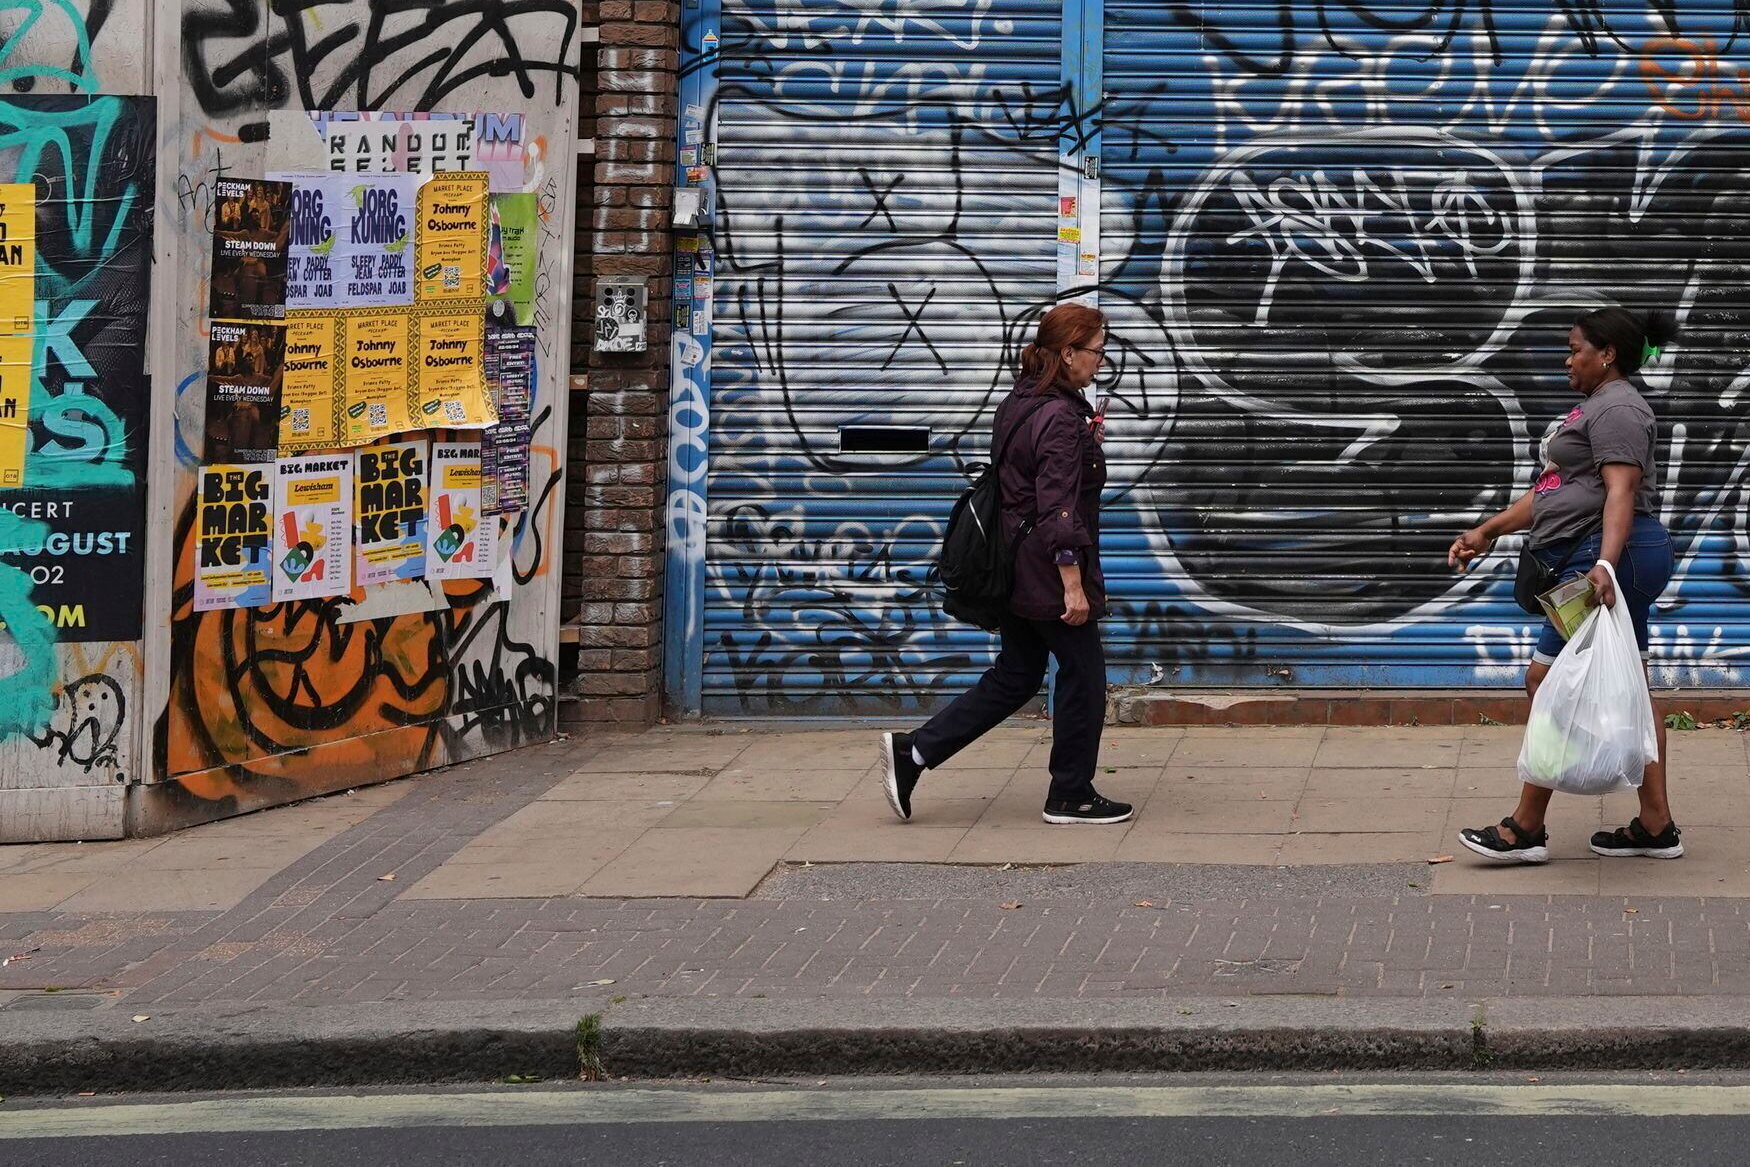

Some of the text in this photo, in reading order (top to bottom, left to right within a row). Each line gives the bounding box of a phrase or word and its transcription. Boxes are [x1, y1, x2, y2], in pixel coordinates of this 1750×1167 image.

[217, 182, 251, 191] PECKHAM
[217, 189, 244, 198] LEVELS
[292, 189, 323, 217] ORG
[433, 203, 471, 217] Johnny
[289, 216, 332, 245] UNING
[351, 215, 406, 244] KUNING
[428, 219, 476, 231] Osbourne
[225, 240, 276, 251] STEAM DOWN
[307, 256, 329, 270] PADDY
[351, 254, 403, 269] SLEEPY PADDY
[304, 268, 332, 282] COTTER
[378, 266, 406, 279] COTTER
[314, 284, 333, 297] JOAB
[348, 281, 407, 296] FELDSPAR JOAB
[212, 326, 246, 335] PECKHAM
[357, 319, 398, 329] MARKET PLACE
[430, 320, 451, 328] MARKET
[212, 334, 239, 342] LEVELS
[285, 343, 321, 357] ohnny
[357, 340, 396, 354] Johnny
[430, 339, 468, 353] Johnny
[284, 360, 328, 372] sbourne
[351, 356, 403, 369] Osbourne
[425, 355, 473, 367] Osbourne
[219, 385, 270, 395] STEAM DOWN
[243, 395, 274, 403] WEDNESDAY
[437, 449, 458, 458] BIG
[280, 460, 349, 475] BIG MARKET
[360, 448, 423, 483] BIG
[204, 471, 269, 503] BIG
[294, 482, 334, 493] Lewisham
[361, 478, 423, 514] MAR
[2, 502, 74, 518] CERT
[203, 503, 267, 535] MAR
[361, 508, 424, 544] KET
[0, 532, 131, 556] GUST
[201, 534, 267, 568] KET
